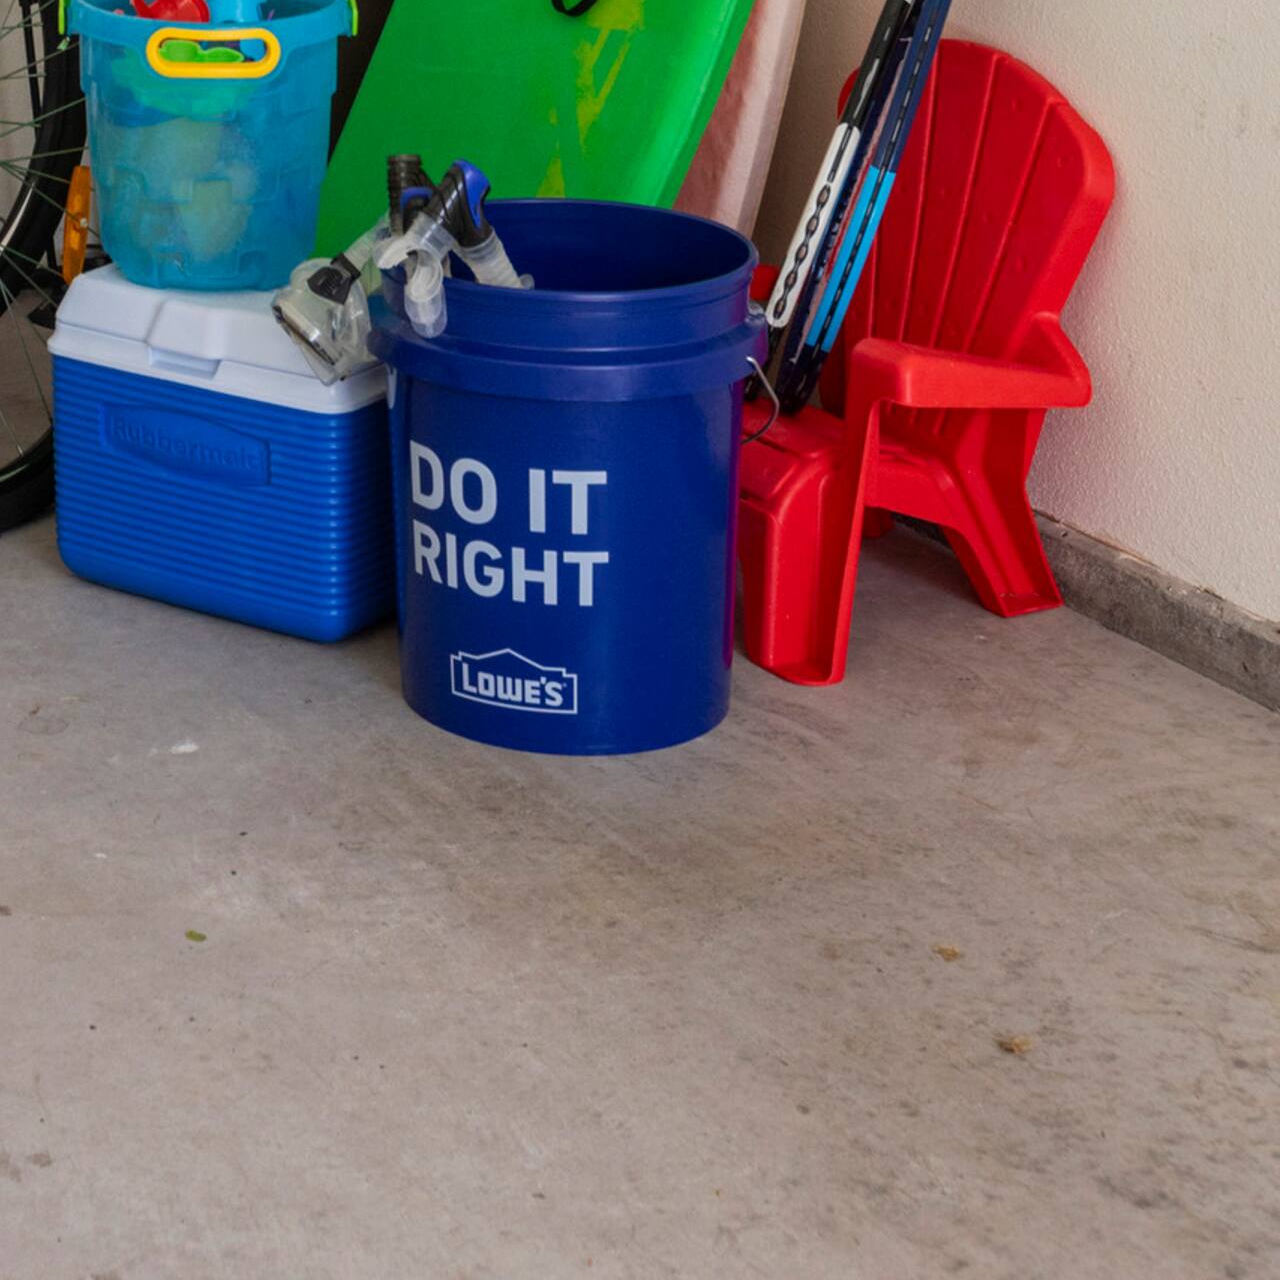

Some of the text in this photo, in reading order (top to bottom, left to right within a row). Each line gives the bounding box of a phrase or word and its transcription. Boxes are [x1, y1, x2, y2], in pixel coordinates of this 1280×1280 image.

[410, 439, 607, 535] DO IT
[413, 518, 609, 607] RIGHT
[462, 661, 564, 706] LOWE'S
